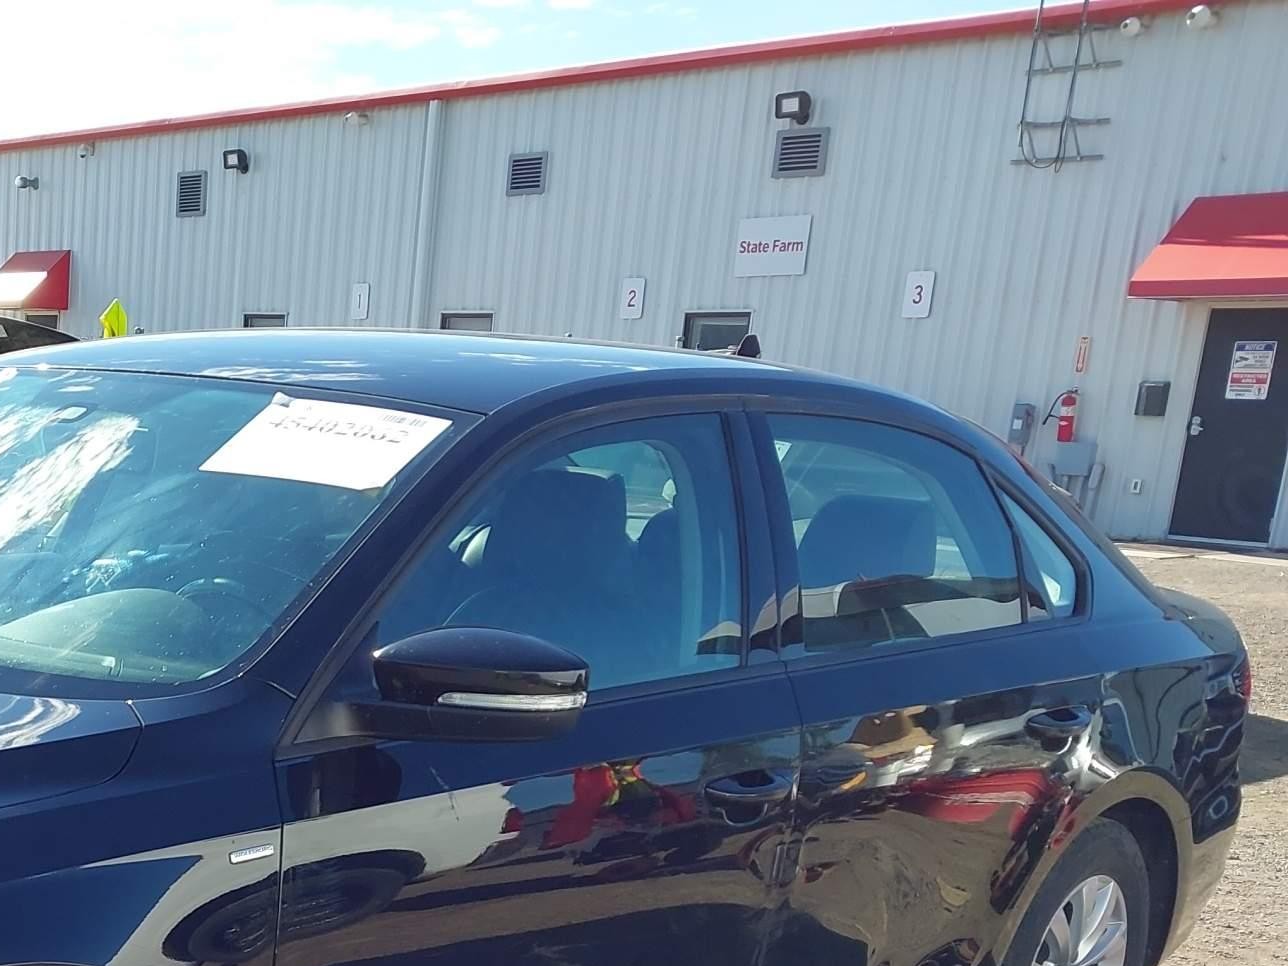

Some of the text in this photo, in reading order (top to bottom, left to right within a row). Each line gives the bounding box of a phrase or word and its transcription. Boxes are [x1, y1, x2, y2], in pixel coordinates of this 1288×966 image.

[738, 239, 804, 254] State Farm
[627, 289, 637, 308] 2
[912, 284, 924, 305] 3
